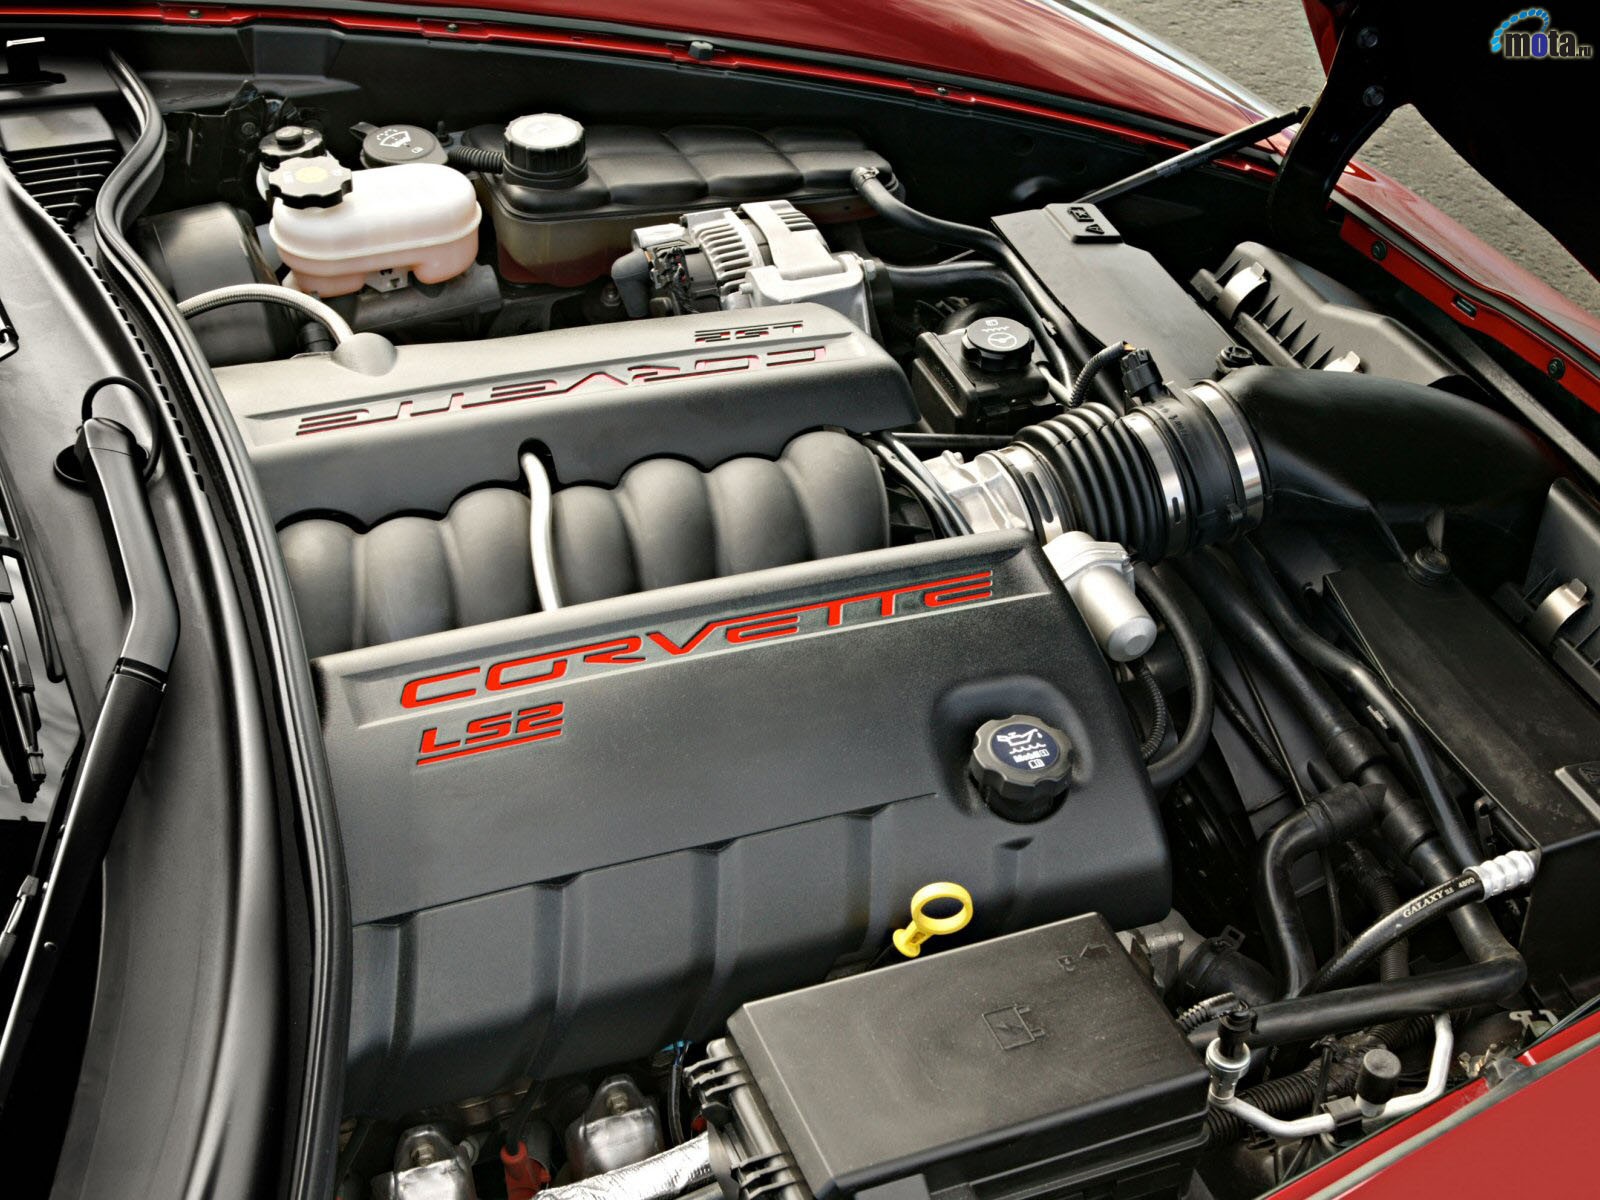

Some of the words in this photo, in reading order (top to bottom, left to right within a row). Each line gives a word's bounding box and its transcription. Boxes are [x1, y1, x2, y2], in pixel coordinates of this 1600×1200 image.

[295, 345, 827, 437] CORVETTE
[401, 571, 992, 709] CORVETTE
[420, 703, 565, 754] LS2
[1403, 890, 1444, 918] GALAXY
